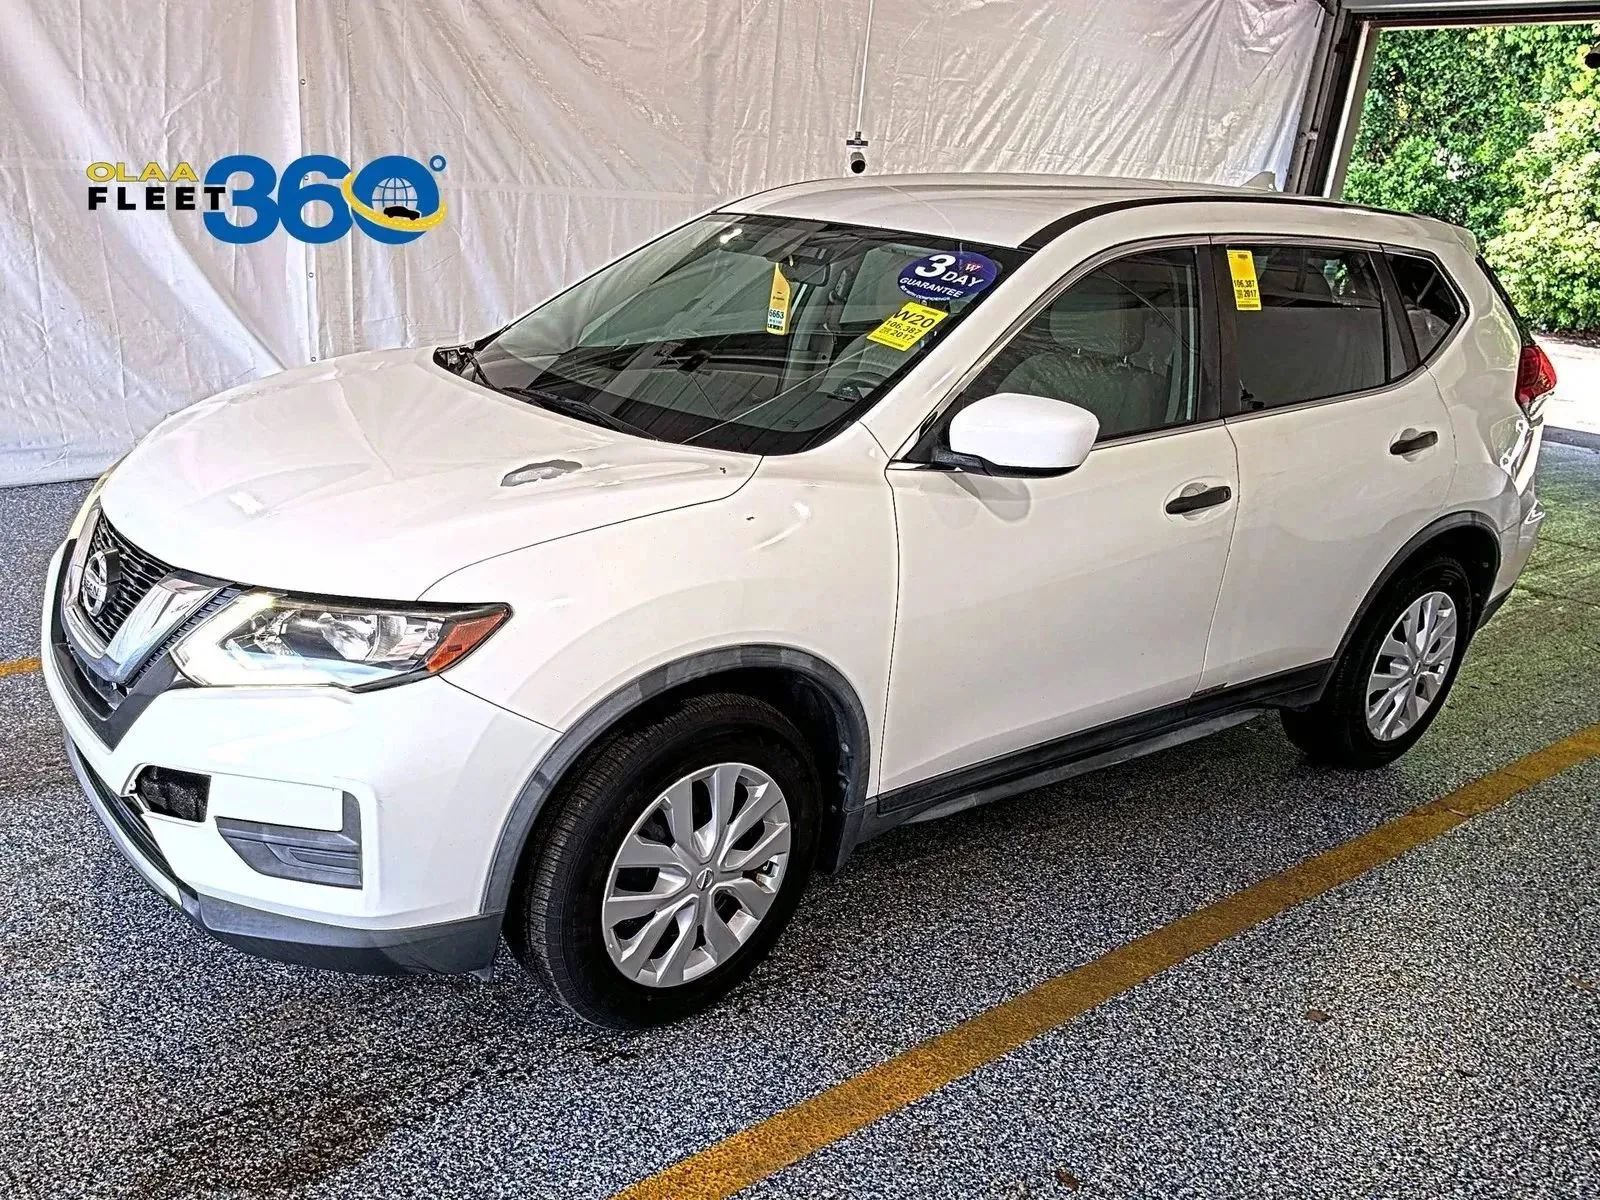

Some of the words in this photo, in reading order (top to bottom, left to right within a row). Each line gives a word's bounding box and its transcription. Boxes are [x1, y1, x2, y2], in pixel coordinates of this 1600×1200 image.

[915, 254, 956, 278] 3
[941, 271, 984, 287] DAY
[900, 277, 964, 298] GUARANTEE
[1243, 289, 1257, 298] 2017
[893, 309, 936, 329] W20
[890, 330, 916, 341] 2017
